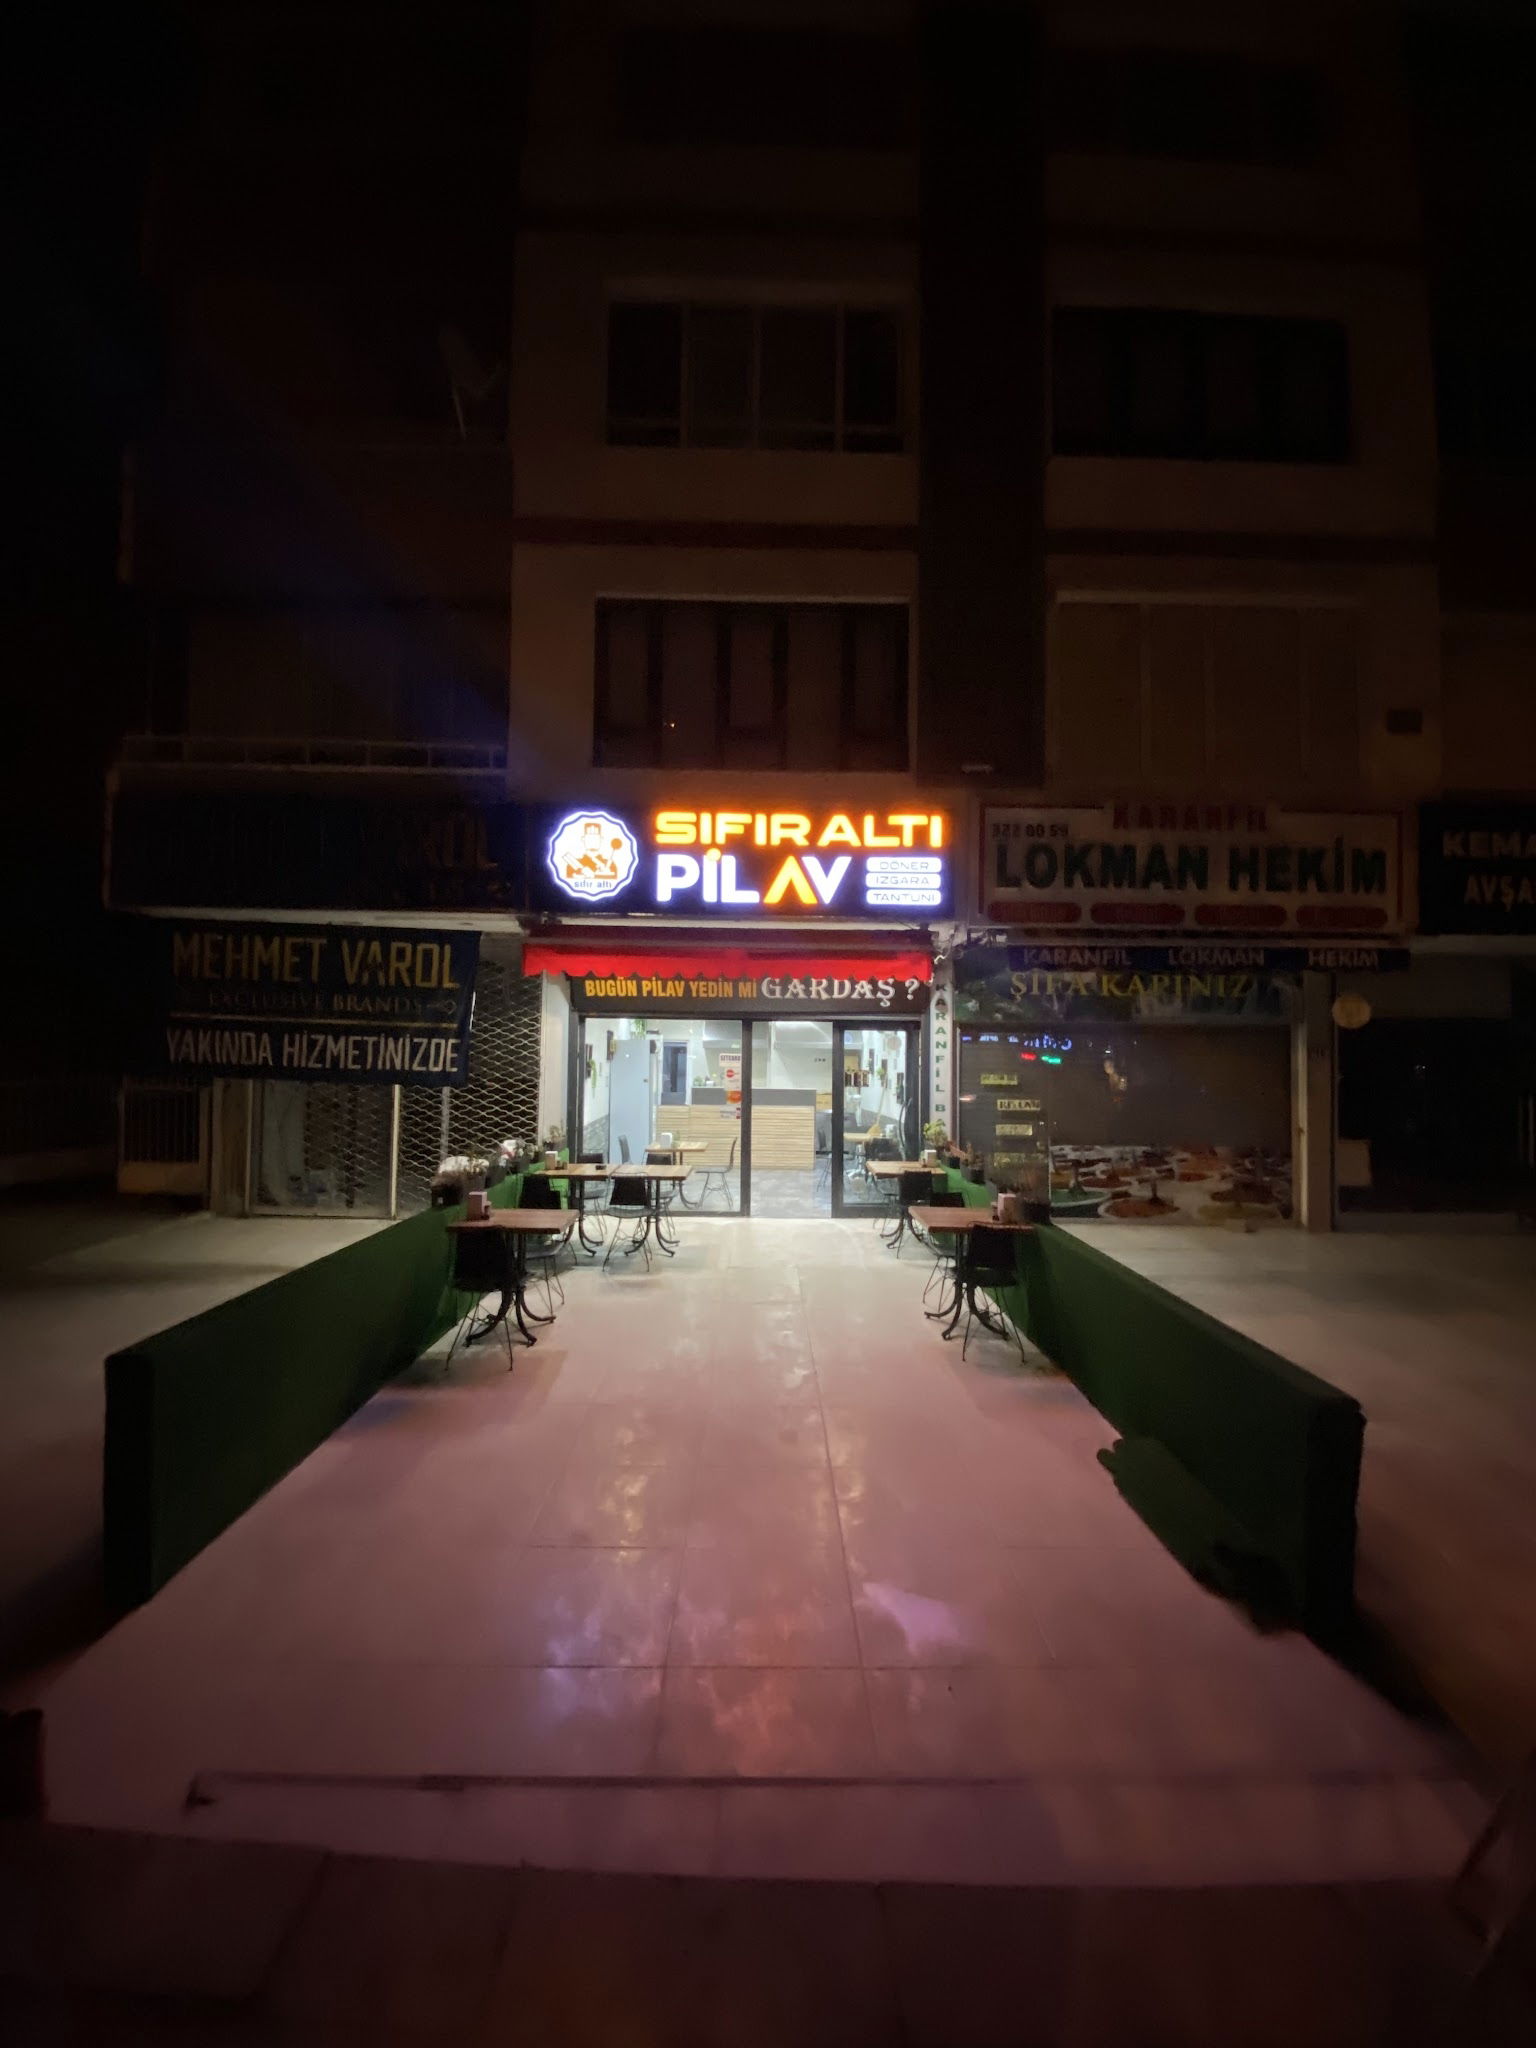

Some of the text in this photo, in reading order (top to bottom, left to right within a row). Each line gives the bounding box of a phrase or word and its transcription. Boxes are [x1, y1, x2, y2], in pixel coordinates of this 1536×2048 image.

[655, 848, 853, 906] PİLAV
[875, 875, 930, 885] IZGARA
[879, 860, 930, 871] DÖNER
[995, 837, 1388, 895] LOKMAN HEKİM
[171, 929, 460, 990] MEHMET VAROL
[1168, 947, 1265, 966] LOKMAN
[584, 976, 638, 998] BUGÜN
[642, 976, 685, 998] PİLAV
[690, 977, 734, 998] YEDİN
[760, 977, 896, 1008] GARDAŞ
[165, 1026, 462, 1073] YAKINDA HİZMETİNİZDE
